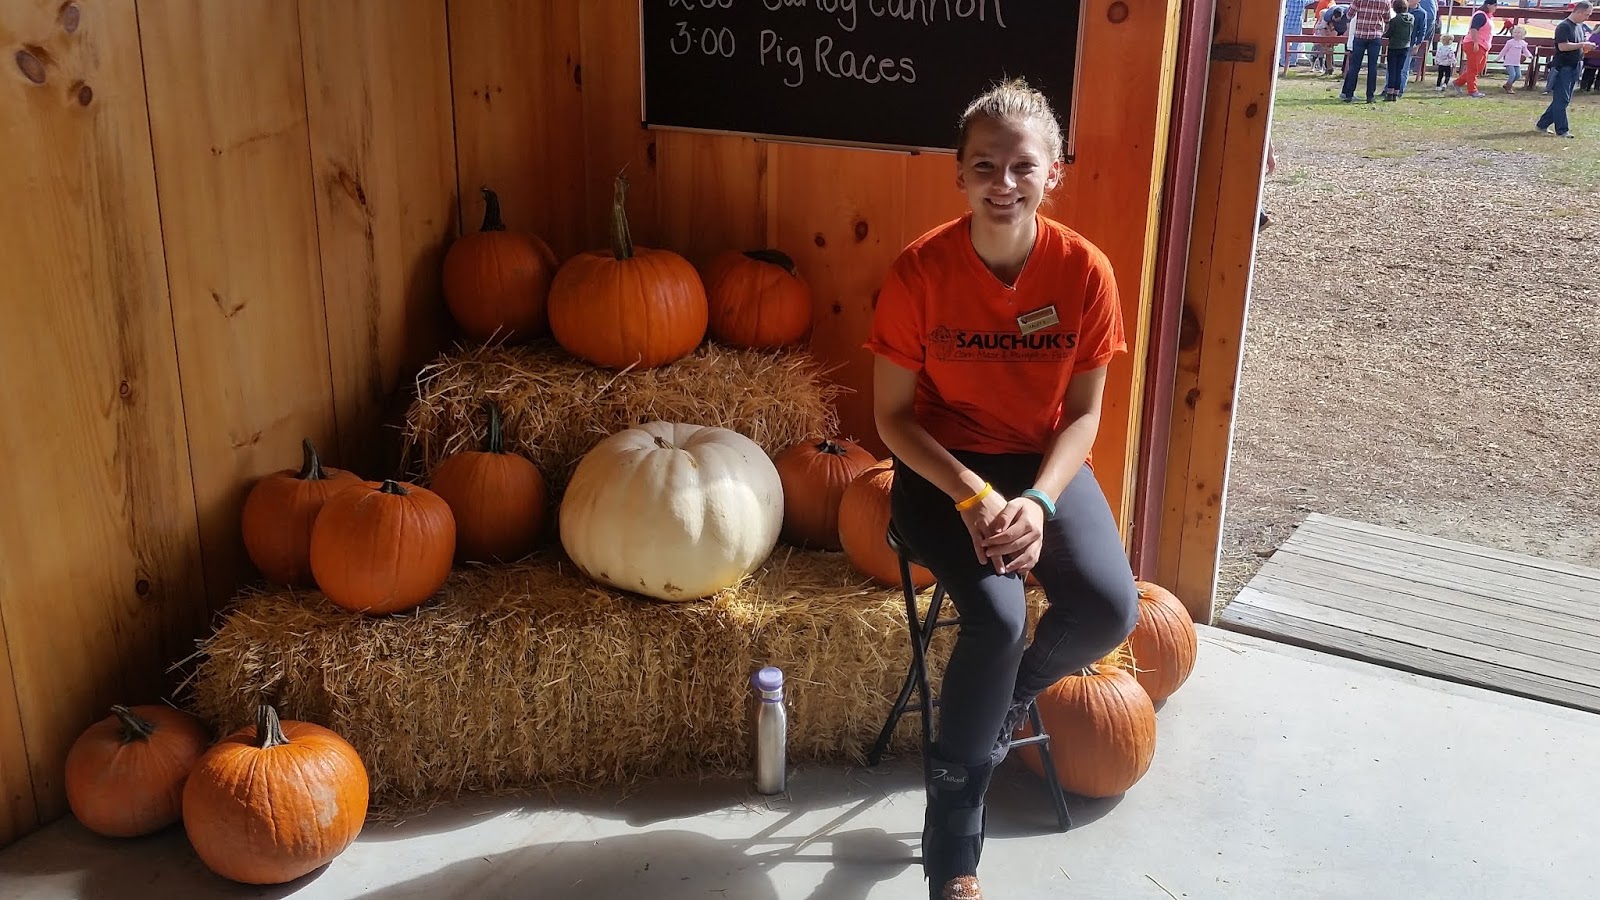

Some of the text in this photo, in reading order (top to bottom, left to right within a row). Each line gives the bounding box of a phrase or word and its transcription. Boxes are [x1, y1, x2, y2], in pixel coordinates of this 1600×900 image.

[670, 21, 917, 88] 3:00 Pig Races
[956, 332, 1077, 350] SAUCHUK'S
